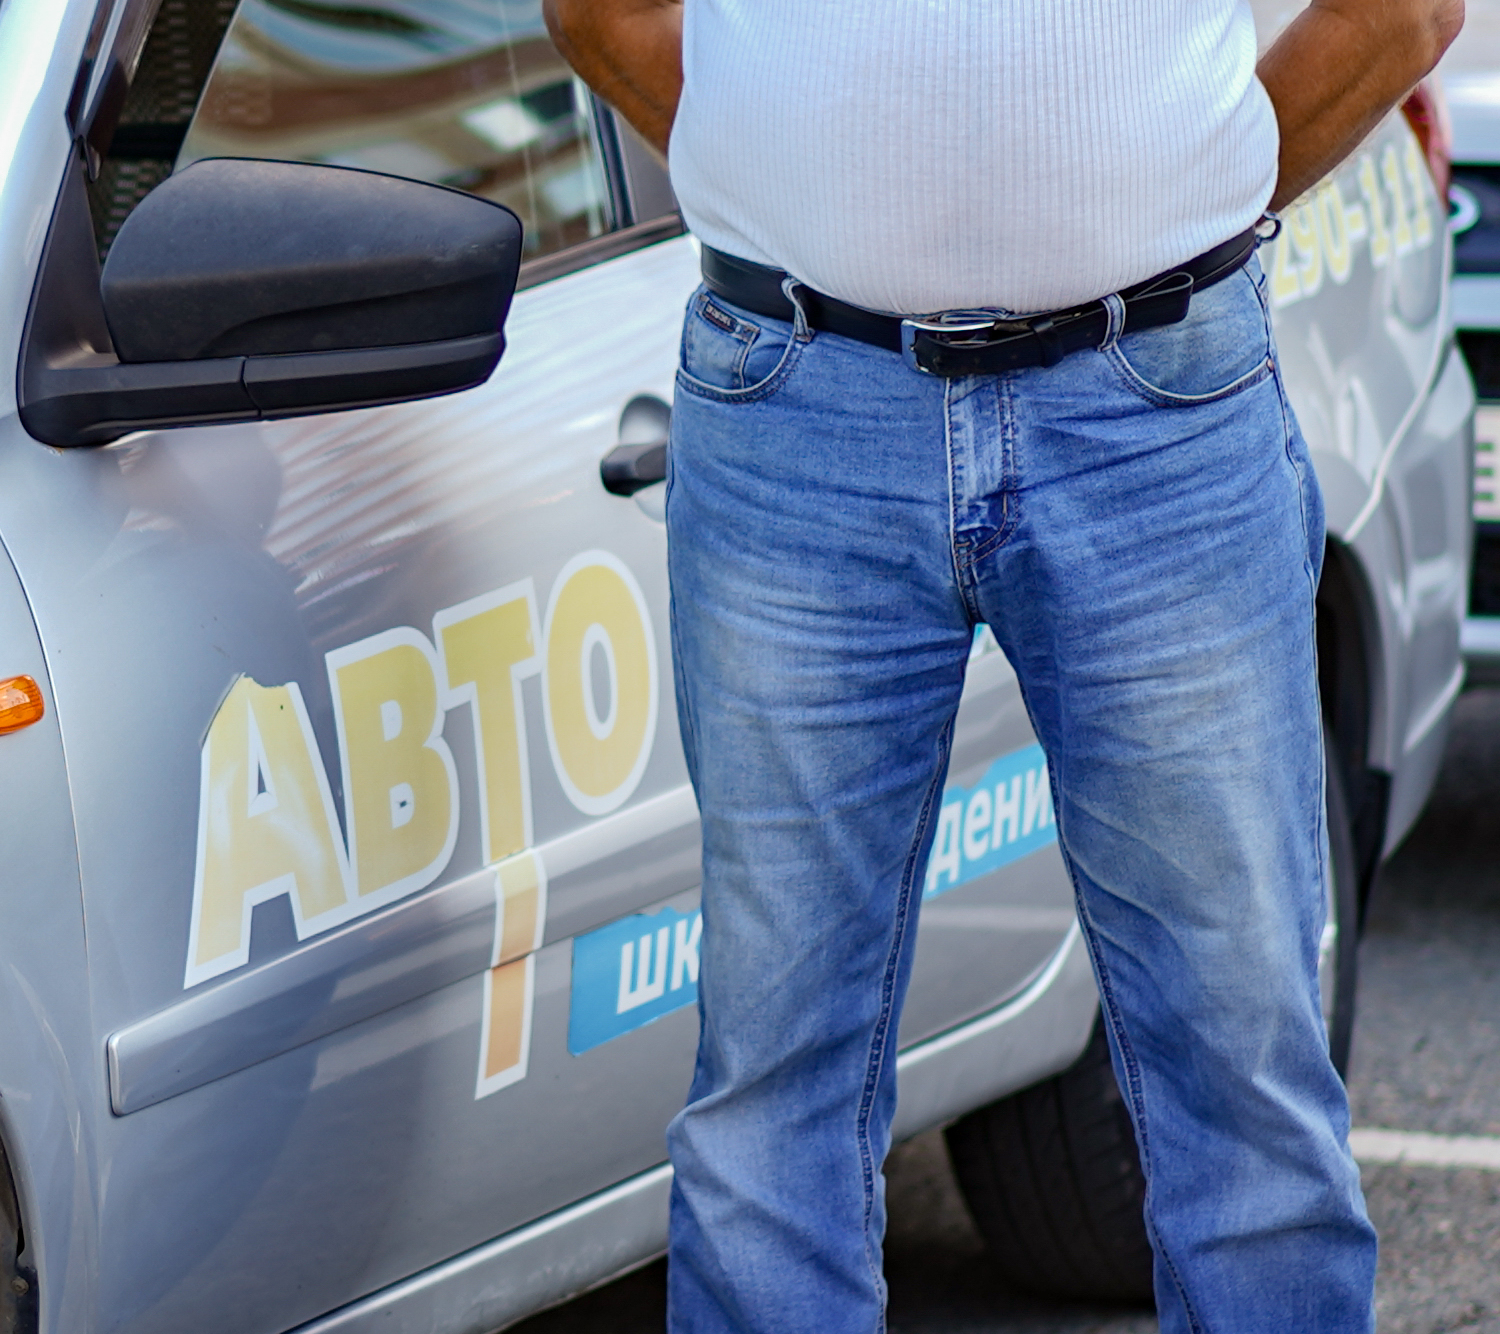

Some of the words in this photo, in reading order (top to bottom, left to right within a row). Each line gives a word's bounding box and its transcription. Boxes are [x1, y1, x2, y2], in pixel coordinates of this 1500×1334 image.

[185, 550, 656, 1099] АВТО
[616, 913, 703, 1015] шк
[927, 764, 1056, 892] дени
